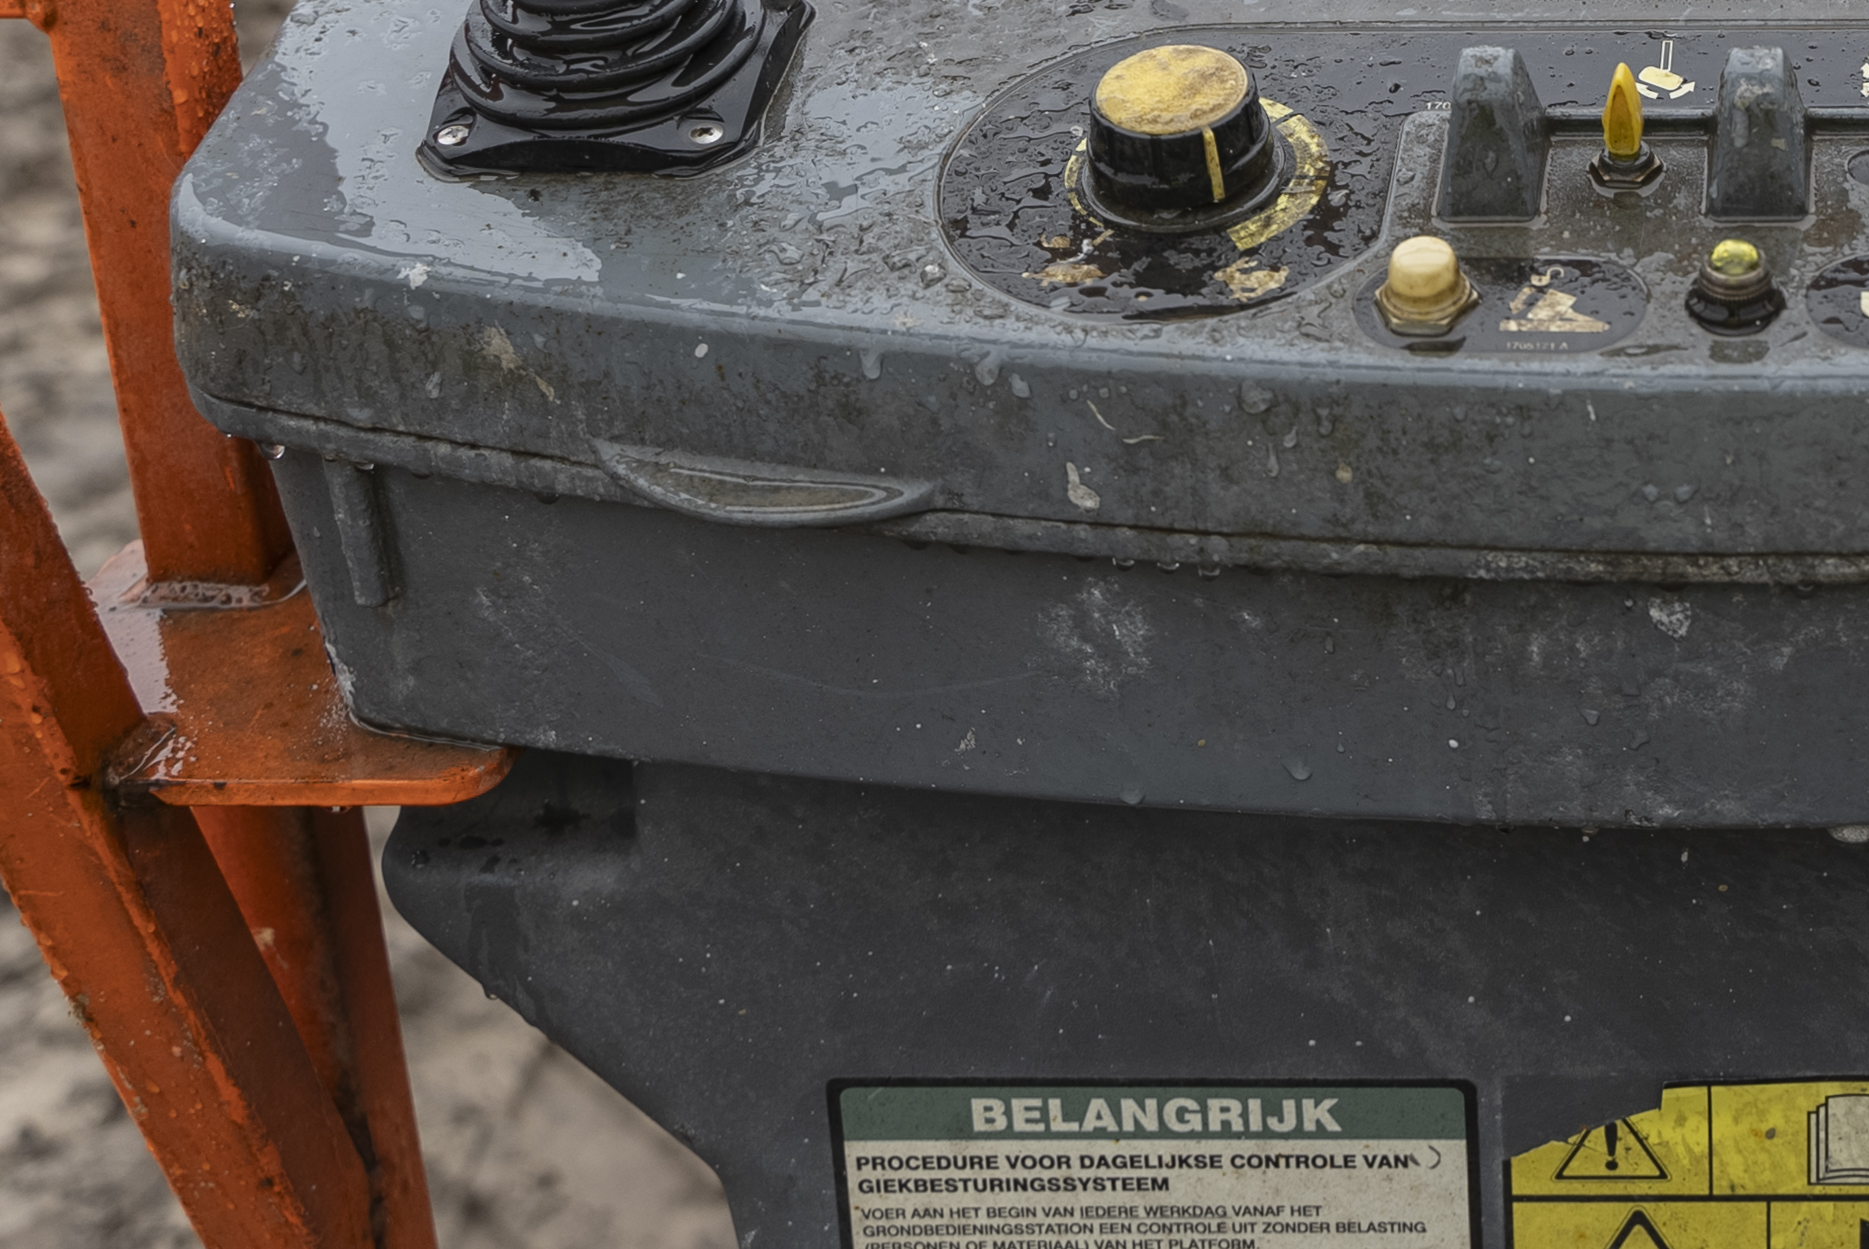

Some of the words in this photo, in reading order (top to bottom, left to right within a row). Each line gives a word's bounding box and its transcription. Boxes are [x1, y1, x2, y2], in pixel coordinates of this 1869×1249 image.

[970, 1097, 1342, 1133] BELANGRIJK
[856, 1155, 999, 1171] PROCEDURE
[1005, 1154, 1071, 1170] VOOR
[1079, 1154, 1223, 1170] DAGELIJKSE
[1230, 1154, 1357, 1169] CONTROLE
[1363, 1154, 1409, 1169] VAN
[858, 1177, 1170, 1194] GIEKBESTURINGSSYSTEEM
[861, 1207, 906, 1220] VOER
[911, 1207, 944, 1219] AAN
[950, 1207, 981, 1219] HET
[986, 1207, 1036, 1219] BEGIN
[1042, 1207, 1075, 1219] VAN
[1080, 1206, 1139, 1219] IEDERE
[1144, 1205, 1227, 1218] WERKDAG
[1232, 1205, 1285, 1218] VANAF
[1290, 1205, 1323, 1217] HET
[863, 1223, 1093, 1237] GRONDBEDIENINGSSTATION
[1099, 1223, 1132, 1235] EEN
[1137, 1222, 1227, 1235] CONTROLE
[1232, 1222, 1257, 1234] UIT
[1263, 1222, 1330, 1234] ZONDER
[1336, 1221, 1427, 1234] BELASTING
